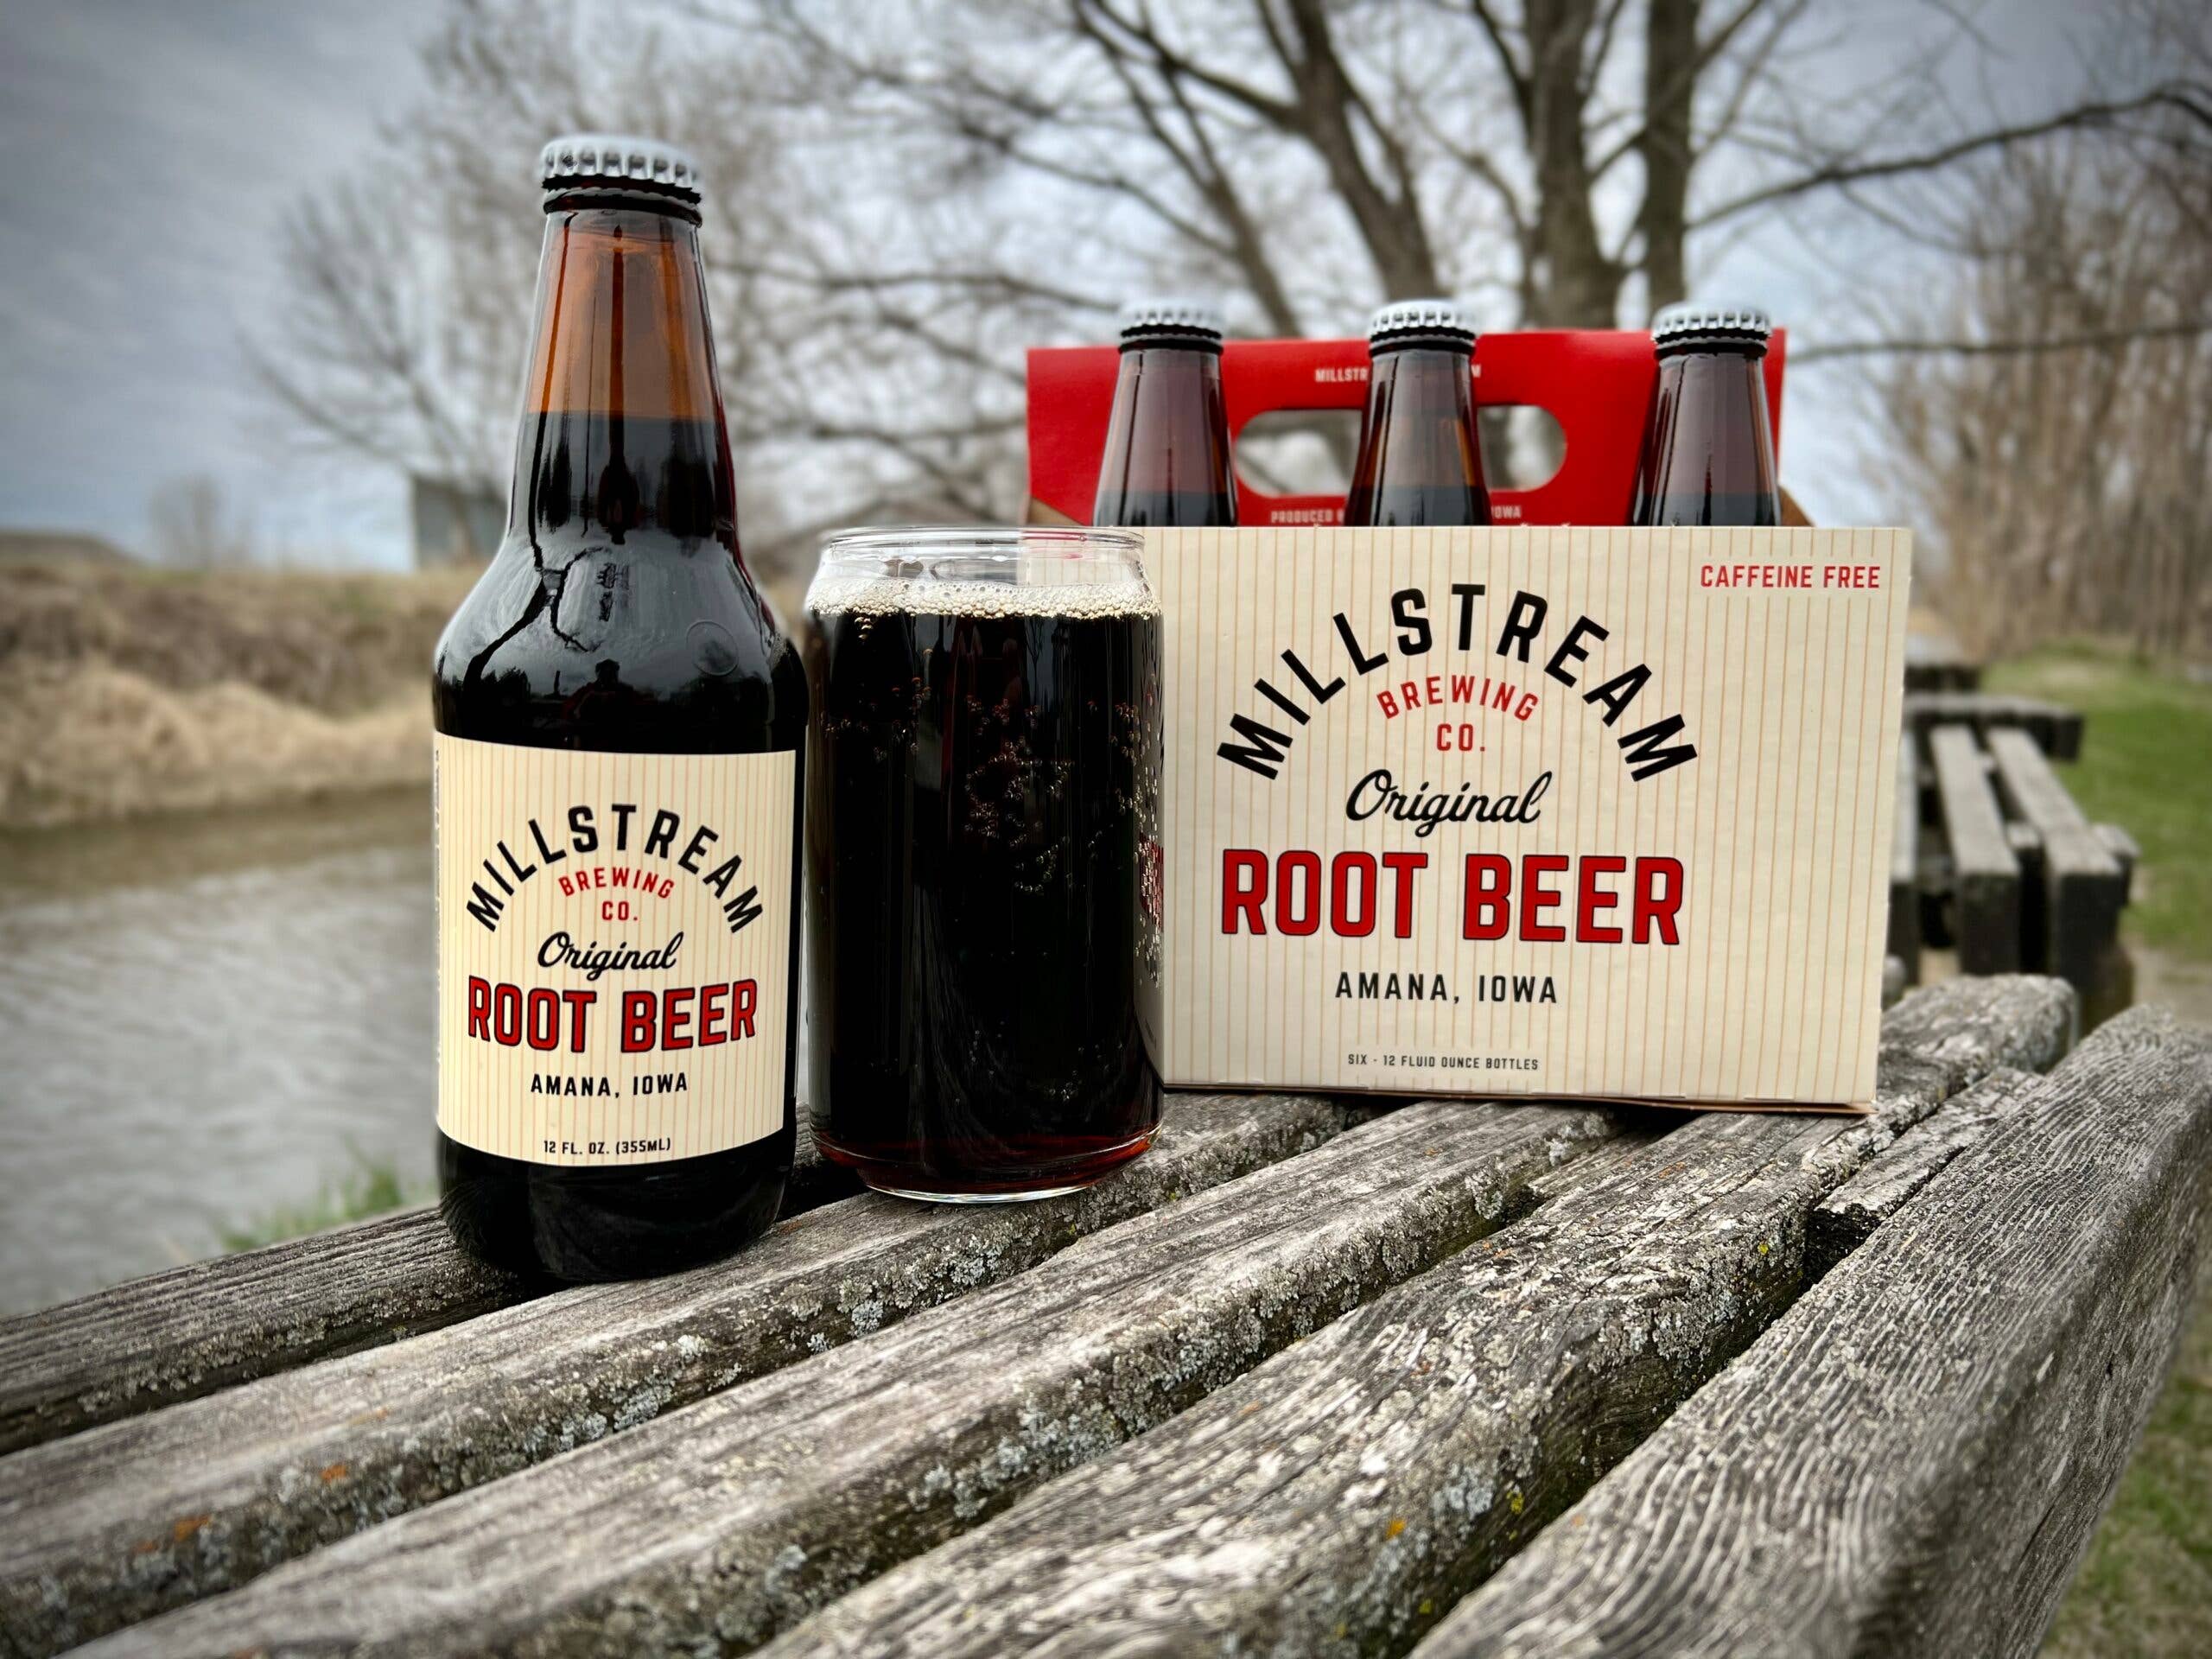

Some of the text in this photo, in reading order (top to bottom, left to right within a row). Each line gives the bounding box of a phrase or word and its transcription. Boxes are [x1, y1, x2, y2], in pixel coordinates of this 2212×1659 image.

[1314, 366, 1369, 383] MILLSTR
[1270, 509, 1333, 524] PRODUCED
[1700, 564, 1880, 588] CAFFEINE FREE
[1217, 583, 1698, 782] MILLSTREAM
[1377, 675, 1539, 722] BREWING
[1436, 723, 1486, 752] CO.
[1345, 769, 1553, 838] Original
[466, 803, 763, 933] MILLSTREAM
[558, 867, 676, 899] BREWING
[601, 901, 639, 922] CO.
[1221, 849, 1429, 939] ROOT
[1462, 853, 1684, 945] BEER
[537, 931, 684, 982] Original
[1335, 971, 1558, 1005] AMANA, IOWA
[467, 975, 758, 1053] ROOT BEER
[1348, 1054, 1367, 1065] SIX
[1383, 1055, 1395, 1066] 12
[1401, 1055, 1435, 1067] FLUID
[1441, 1057, 1480, 1069] OUNCE
[1485, 1058, 1539, 1071] BOTTLES
[531, 1071, 688, 1098] AMANA, IOWA
[543, 1137, 671, 1155] 12 FL. OZ. (355ML)
